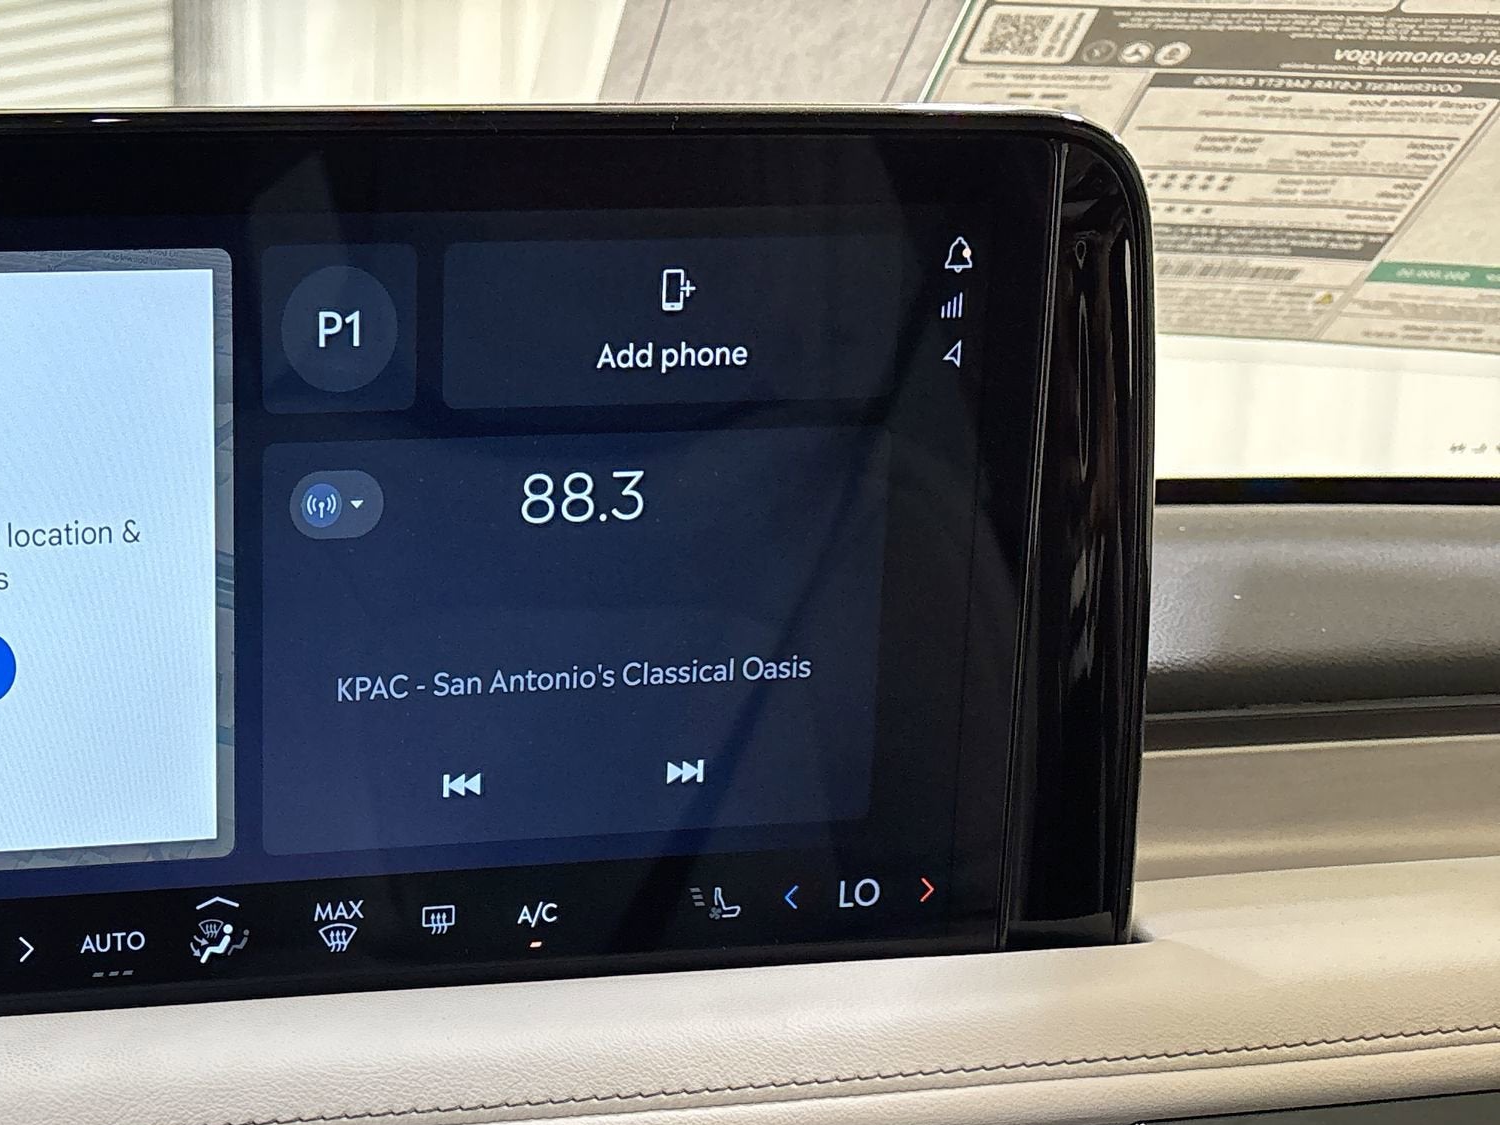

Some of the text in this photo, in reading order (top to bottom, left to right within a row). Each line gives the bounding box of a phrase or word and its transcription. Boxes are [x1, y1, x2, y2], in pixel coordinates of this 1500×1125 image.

[318, 310, 360, 348] P1
[596, 341, 748, 374] Add phone
[521, 470, 645, 524] 88.3
[7, 519, 113, 548] location
[122, 519, 141, 544] &
[337, 674, 409, 702] KPAC
[433, 672, 482, 697] San
[489, 664, 615, 694] Antonio's
[622, 657, 735, 686] Classical
[742, 654, 811, 681] Oasis
[839, 878, 880, 908] LO
[314, 899, 364, 922] MAX
[517, 901, 558, 928] A/C
[80, 930, 146, 954] AUTO
